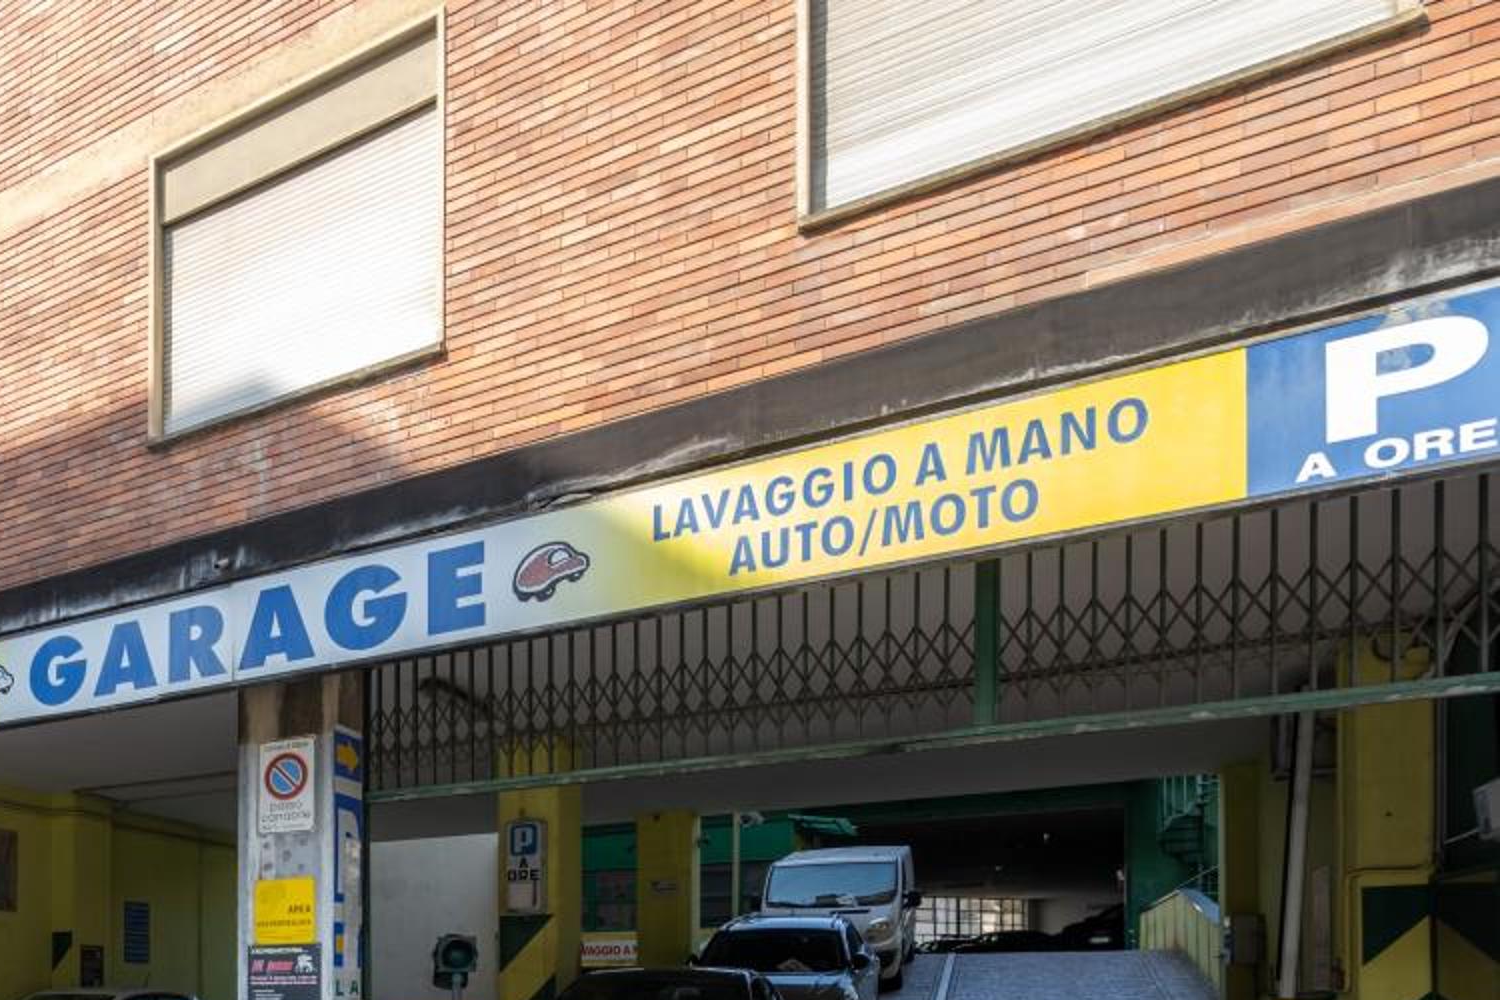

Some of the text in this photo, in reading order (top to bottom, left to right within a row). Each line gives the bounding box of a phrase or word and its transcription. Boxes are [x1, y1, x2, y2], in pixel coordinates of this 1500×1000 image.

[1324, 315, 1490, 444] P
[652, 397, 1150, 542] LAVAGGIO A MANO
[1295, 417, 1499, 483] A ORE
[727, 478, 1040, 577] AUTO/MOTO
[27, 540, 487, 707] GARAGE
[513, 827, 533, 853] P
